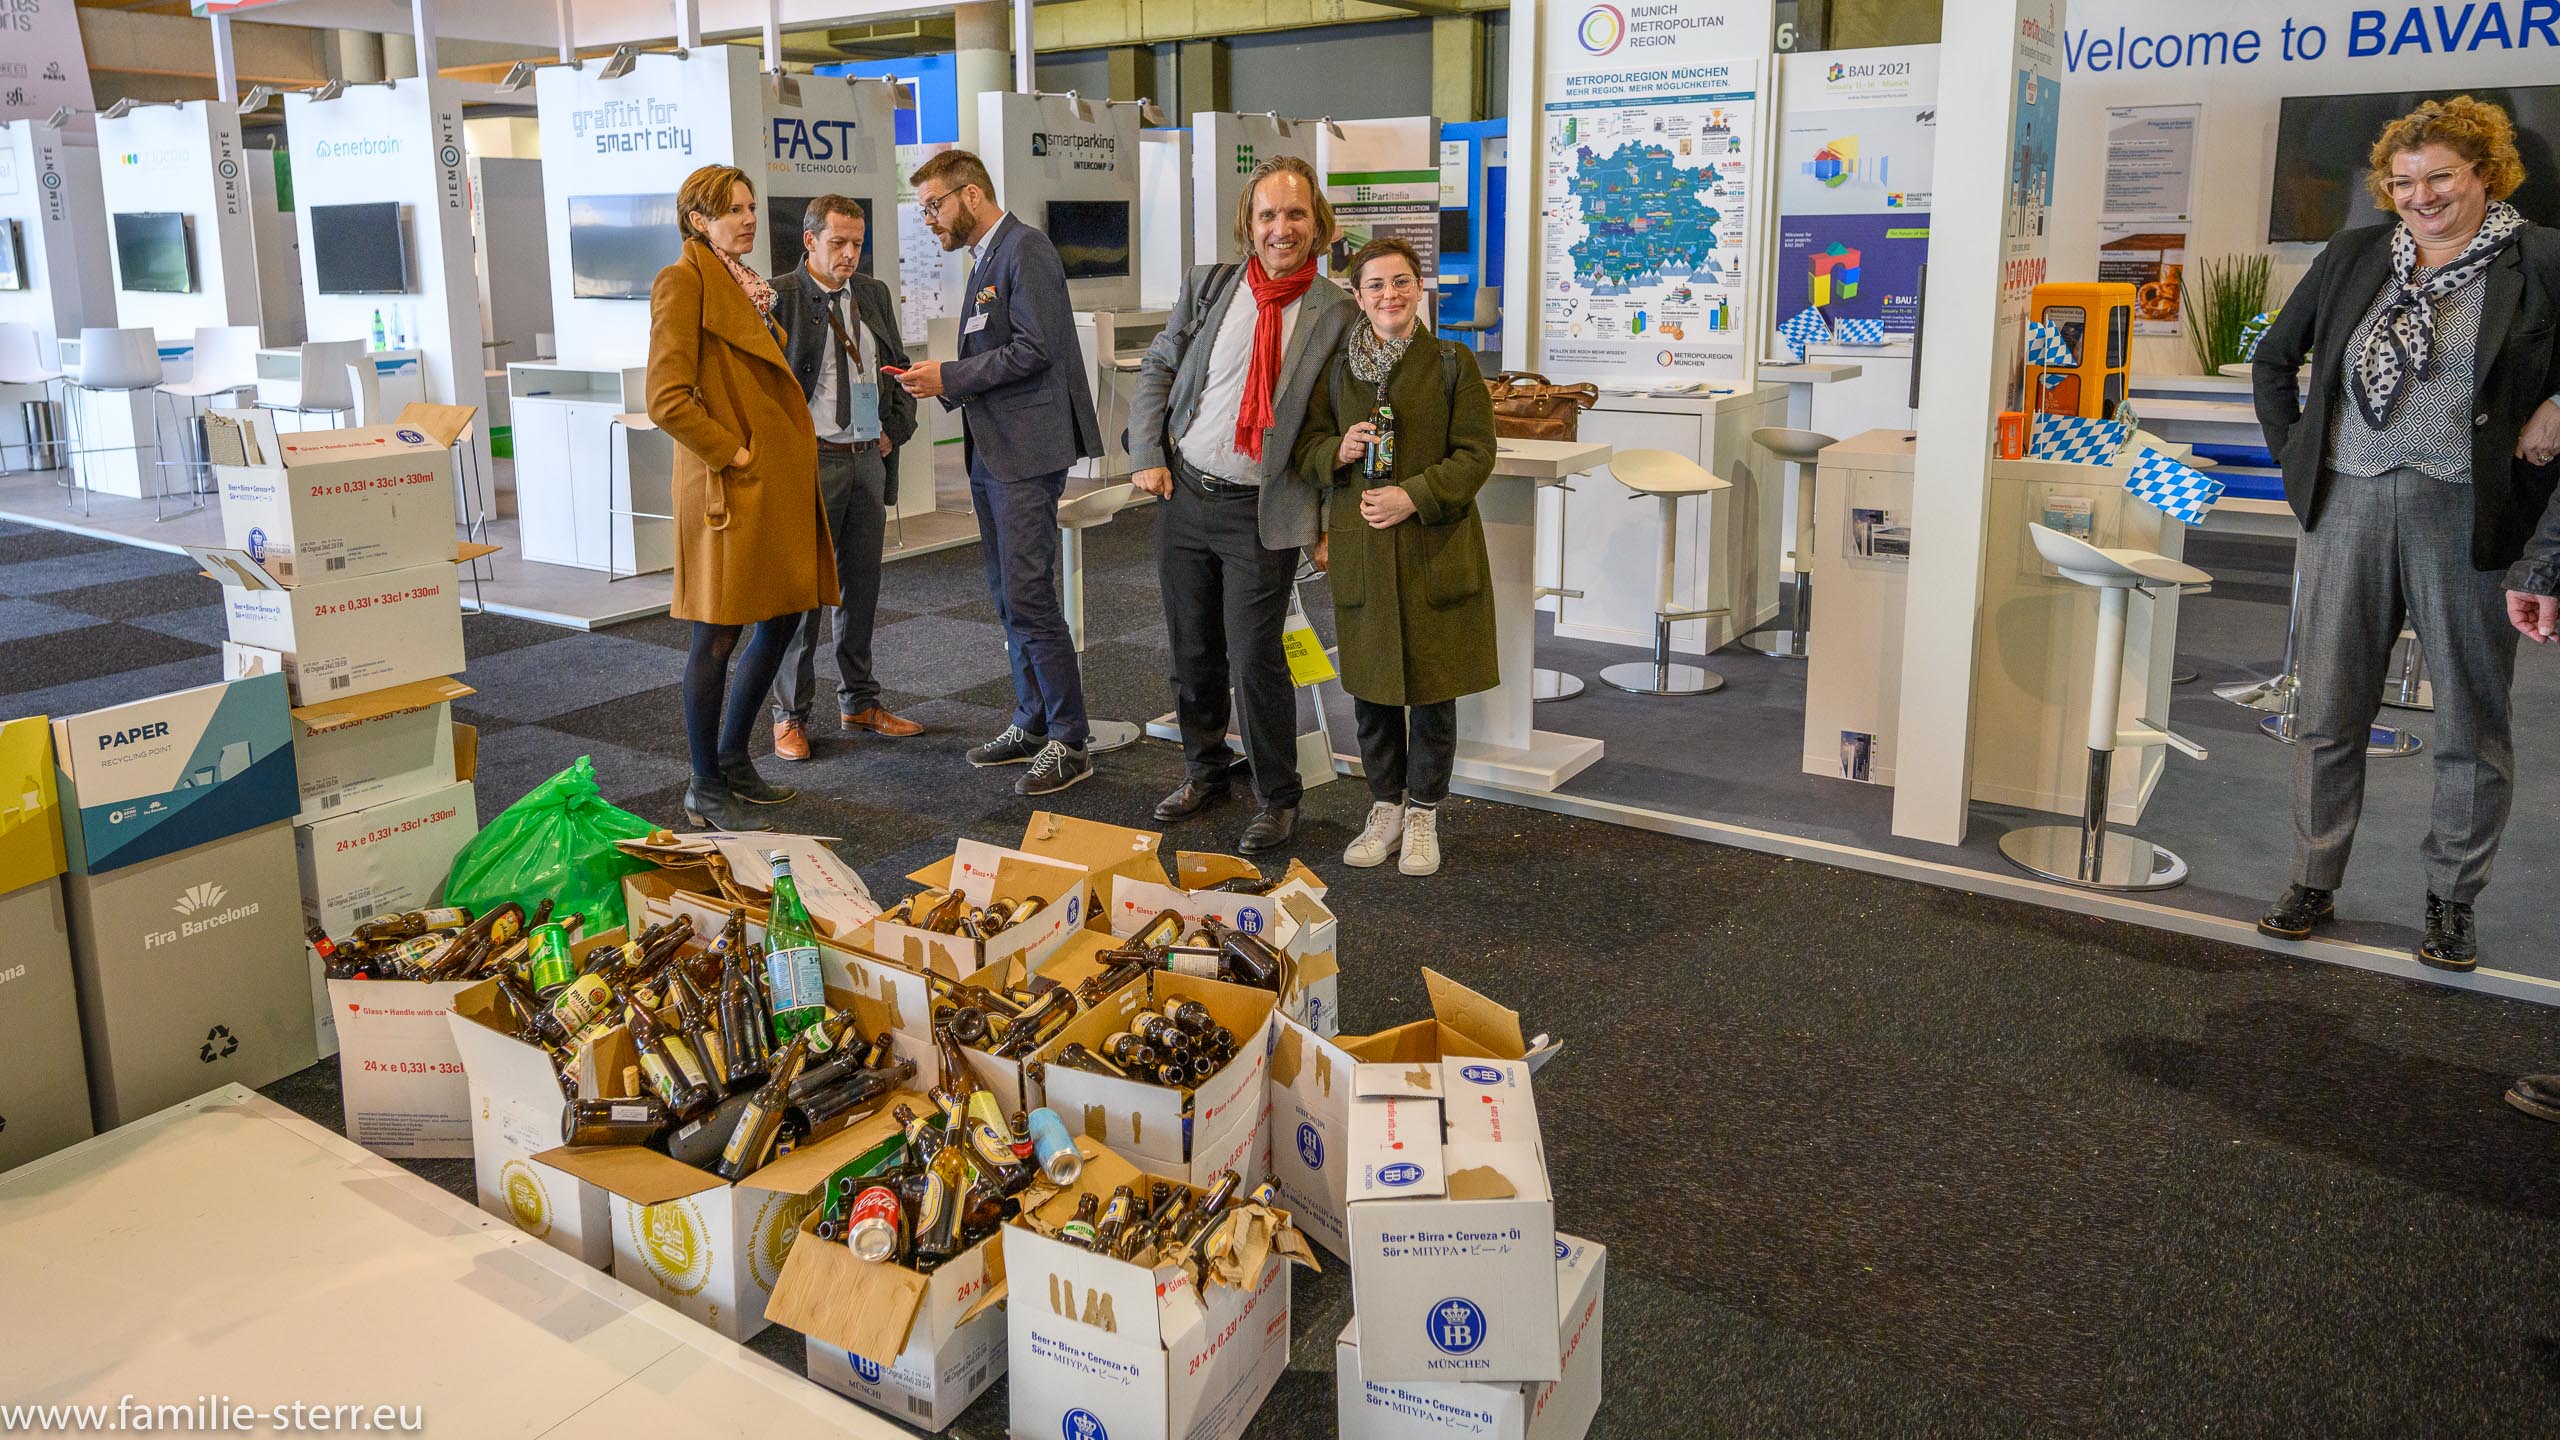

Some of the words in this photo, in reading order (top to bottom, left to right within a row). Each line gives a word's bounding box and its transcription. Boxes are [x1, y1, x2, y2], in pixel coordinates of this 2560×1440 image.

[1631, 4, 1678, 18] MUNICH
[1630, 15, 1724, 33] METROPOLITAN
[1630, 34, 1676, 47] REGION
[2281, 17, 2328, 62] to
[1566, 69, 1668, 86] METROPOLREGION
[1671, 67, 1729, 80] MÜNCHEN
[1849, 65, 1874, 78] BAU
[1878, 62, 1911, 76] 2021
[1566, 87, 1590, 96] MEHR
[1592, 85, 1627, 95] REGION.
[1629, 83, 1654, 93] MEHR
[1656, 79, 1730, 91] MÖGLICHKEITEN.
[572, 100, 643, 138] graffiti
[648, 97, 678, 125] for
[333, 136, 400, 157] enerbrain
[596, 130, 652, 154] smart
[657, 125, 692, 156] city
[773, 117, 856, 161] FAST
[1047, 133, 1115, 152] smartparking
[440, 113, 460, 208] PIEMONTE
[795, 163, 858, 174] TECHNOLOGY
[1074, 161, 1107, 171] INTERCOMP
[1371, 191, 1410, 201] Partitalia
[1674, 352, 1733, 360] METROPOLREGION
[1674, 359, 1705, 367] MÜNCHEN
[311, 485, 324, 497] 24
[325, 487, 333, 495] x
[335, 485, 341, 494] e
[343, 480, 367, 493] 0,33l
[377, 476, 397, 489] 33cl
[406, 472, 434, 485] 330ml
[315, 604, 328, 616] 24
[339, 604, 346, 612] e
[348, 598, 371, 611] 0,33l
[381, 593, 402, 607] 33cl
[411, 585, 440, 601] 330ml
[98, 721, 170, 750] PAPER
[101, 752, 147, 767] RECYCLING
[148, 745, 172, 757] POINT
[336, 839, 349, 852] 24
[351, 839, 358, 847] x
[360, 836, 367, 845] e
[368, 829, 392, 843] 0,33l
[400, 818, 421, 833] 33cl
[430, 807, 456, 824] 330ml
[972, 868, 986, 879] Glass
[1136, 906, 1153, 916] Glass
[1181, 913, 1195, 922] with
[144, 929, 177, 951] Fira
[181, 900, 260, 937] Barcelona
[1243, 919, 1258, 932] HB
[389, 1008, 415, 1016] Handle
[416, 1008, 434, 1016] with
[364, 1060, 377, 1072] 24
[380, 1064, 388, 1072] x
[391, 1064, 397, 1072] e
[400, 1062, 427, 1074] 0,33l
[439, 1062, 465, 1074] 33cl
[1481, 1069, 1497, 1082] HB
[1490, 1105, 1499, 1117] care
[1303, 1129, 1317, 1150] HB
[1207, 1172, 1217, 1187] 24
[1383, 1168, 1400, 1183] HB
[1381, 1232, 1407, 1243] Beer
[1418, 1231, 1445, 1242] Birra
[1456, 1231, 1498, 1242] Cerveza
[1509, 1228, 1521, 1240] Öl
[1383, 1246, 1401, 1257] Sör
[1470, 1244, 1512, 1256] ビール
[957, 1284, 971, 1301] 24
[973, 1280, 980, 1291] x
[1189, 1358, 1201, 1376] 24
[1202, 1350, 1208, 1363] x
[1210, 1343, 1216, 1355] e
[1217, 1322, 1237, 1348] 0,33l
[1242, 1293, 1258, 1320] 33cl
[1442, 1325, 1472, 1346] HB
[1031, 1344, 1046, 1357] Sör
[1031, 1331, 1051, 1346] Beer
[1058, 1339, 1079, 1357] Birra
[1087, 1350, 1121, 1372] Cerveza
[1130, 1363, 1140, 1377] Öl
[859, 1356, 878, 1376] HB
[1427, 1359, 1490, 1369] MÜNCHEN
[1366, 1394, 1383, 1407] Sör
[1366, 1381, 1389, 1394] Beer
[1398, 1390, 1423, 1405] Birra
[1432, 1400, 1471, 1418] Cerveza
[1481, 1411, 1493, 1424] Öl
[1445, 1416, 1482, 1434] ビール
